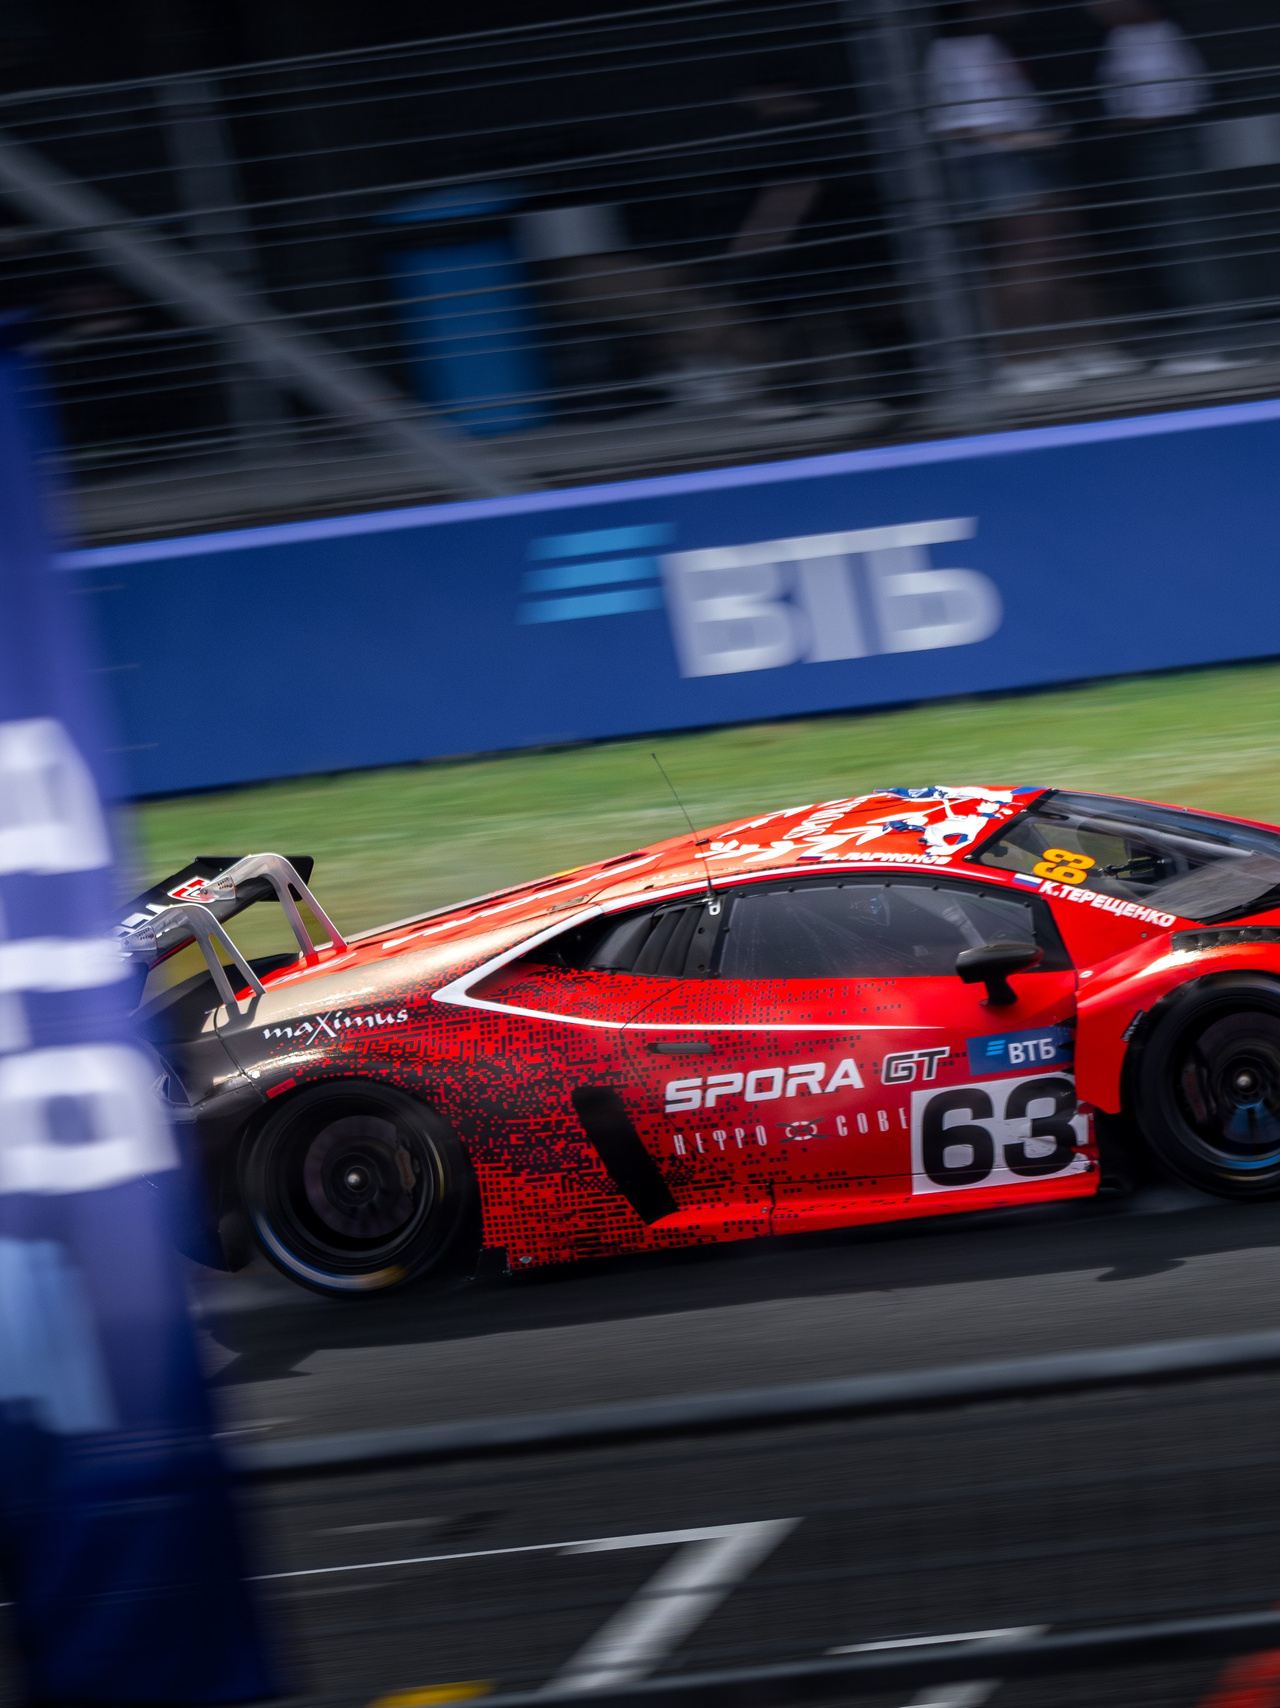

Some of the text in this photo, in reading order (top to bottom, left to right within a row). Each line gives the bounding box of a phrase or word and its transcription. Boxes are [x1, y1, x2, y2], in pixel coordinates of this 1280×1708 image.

[656, 516, 1005, 680] ВТБ
[1032, 848, 1096, 885] 63
[1038, 880, 1177, 928] К.ТЕРЕЩЕНКО
[263, 1008, 409, 1046] maXimus
[1007, 1036, 1057, 1066] ВТБ
[664, 1046, 951, 1113] SPORA GT
[835, 1106, 910, 1138] СОВЕ
[921, 1076, 1079, 1187] 63
